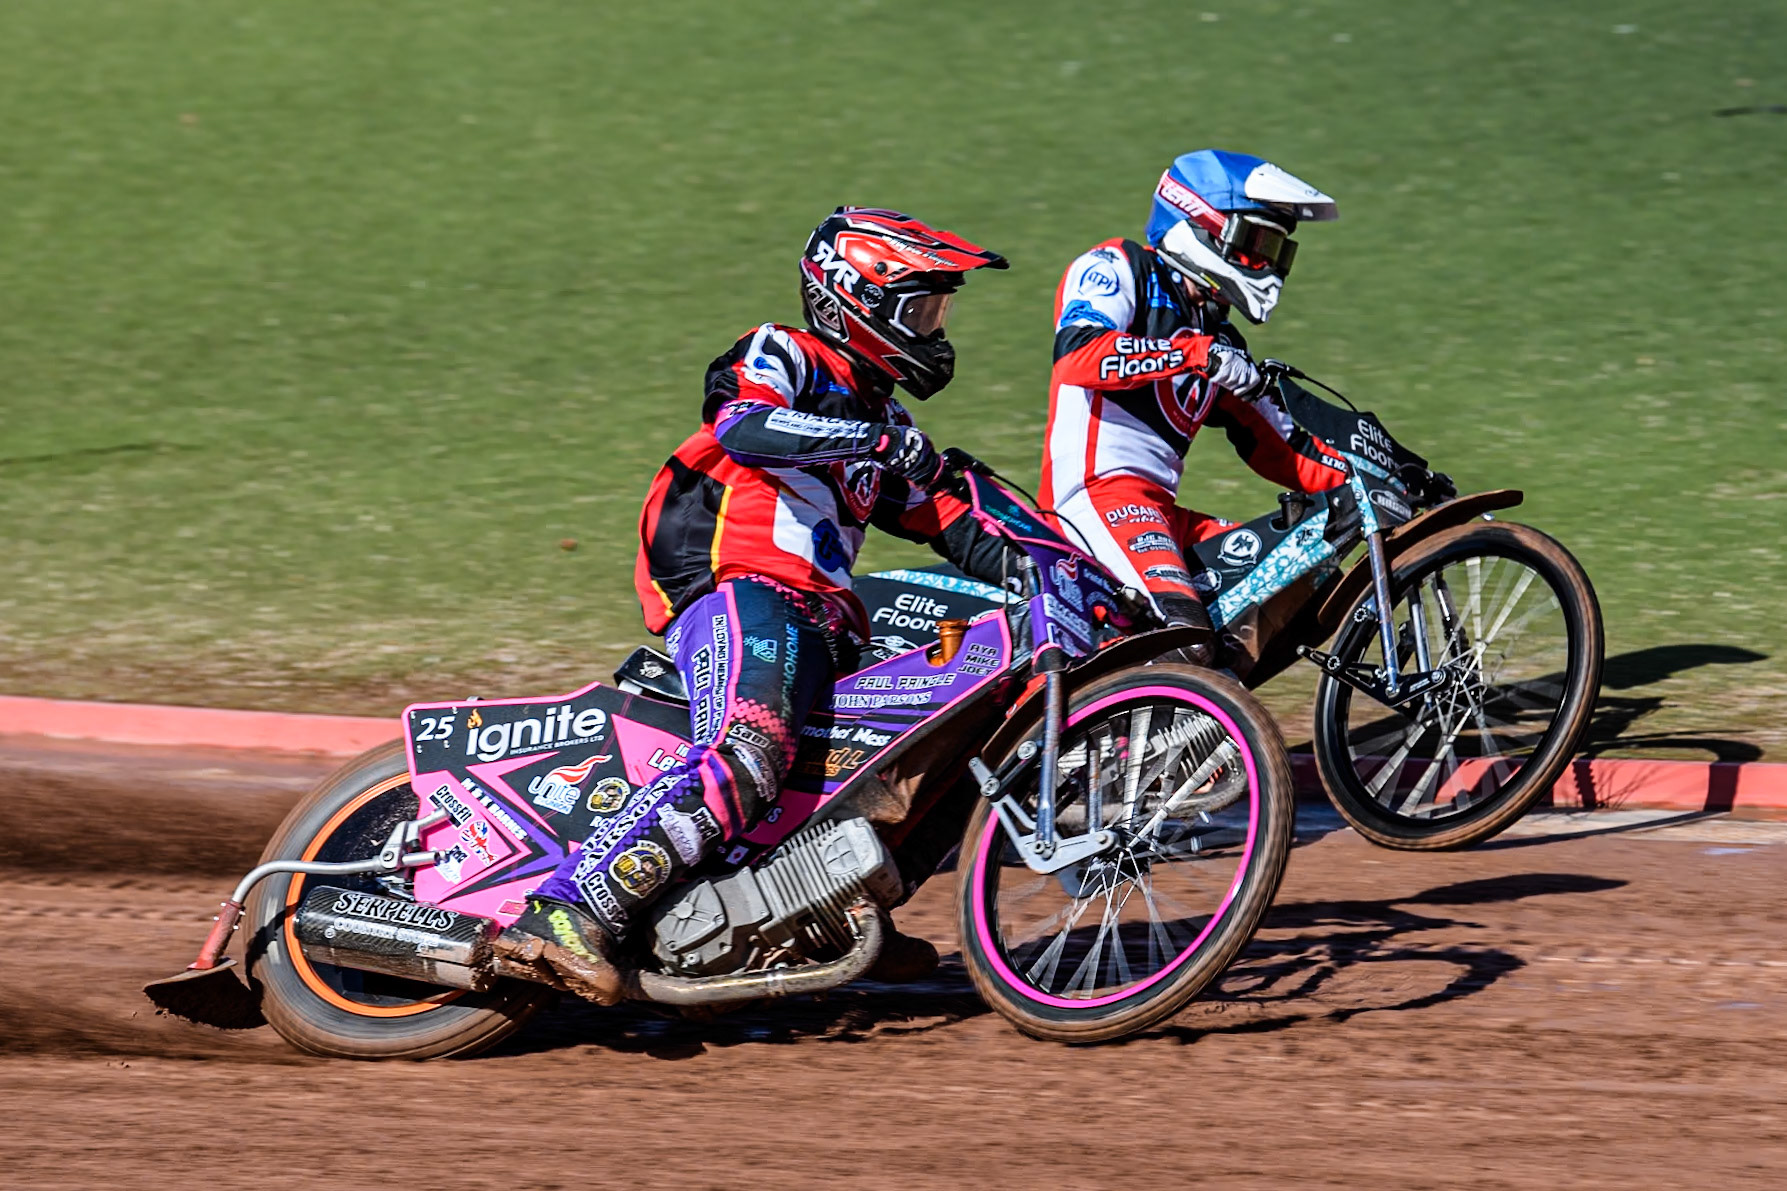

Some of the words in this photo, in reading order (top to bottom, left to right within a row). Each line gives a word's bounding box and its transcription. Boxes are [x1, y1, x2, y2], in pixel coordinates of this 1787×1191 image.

[1115, 336, 1172, 354] Elite
[1100, 349, 1184, 380] Floors
[1357, 418, 1394, 454] Elite
[894, 593, 949, 618] Elite
[964, 655, 1000, 667] MIKE
[854, 676, 894, 690] PAUL
[895, 673, 957, 690] PRINGLE
[416, 716, 456, 741] 25
[466, 704, 607, 762] ignite
[509, 743, 553, 756] INSURANCE
[553, 736, 589, 748] BROKERS
[589, 734, 605, 743] LTD
[436, 784, 473, 823] CrossFit
[332, 891, 460, 931] SERPELLS
